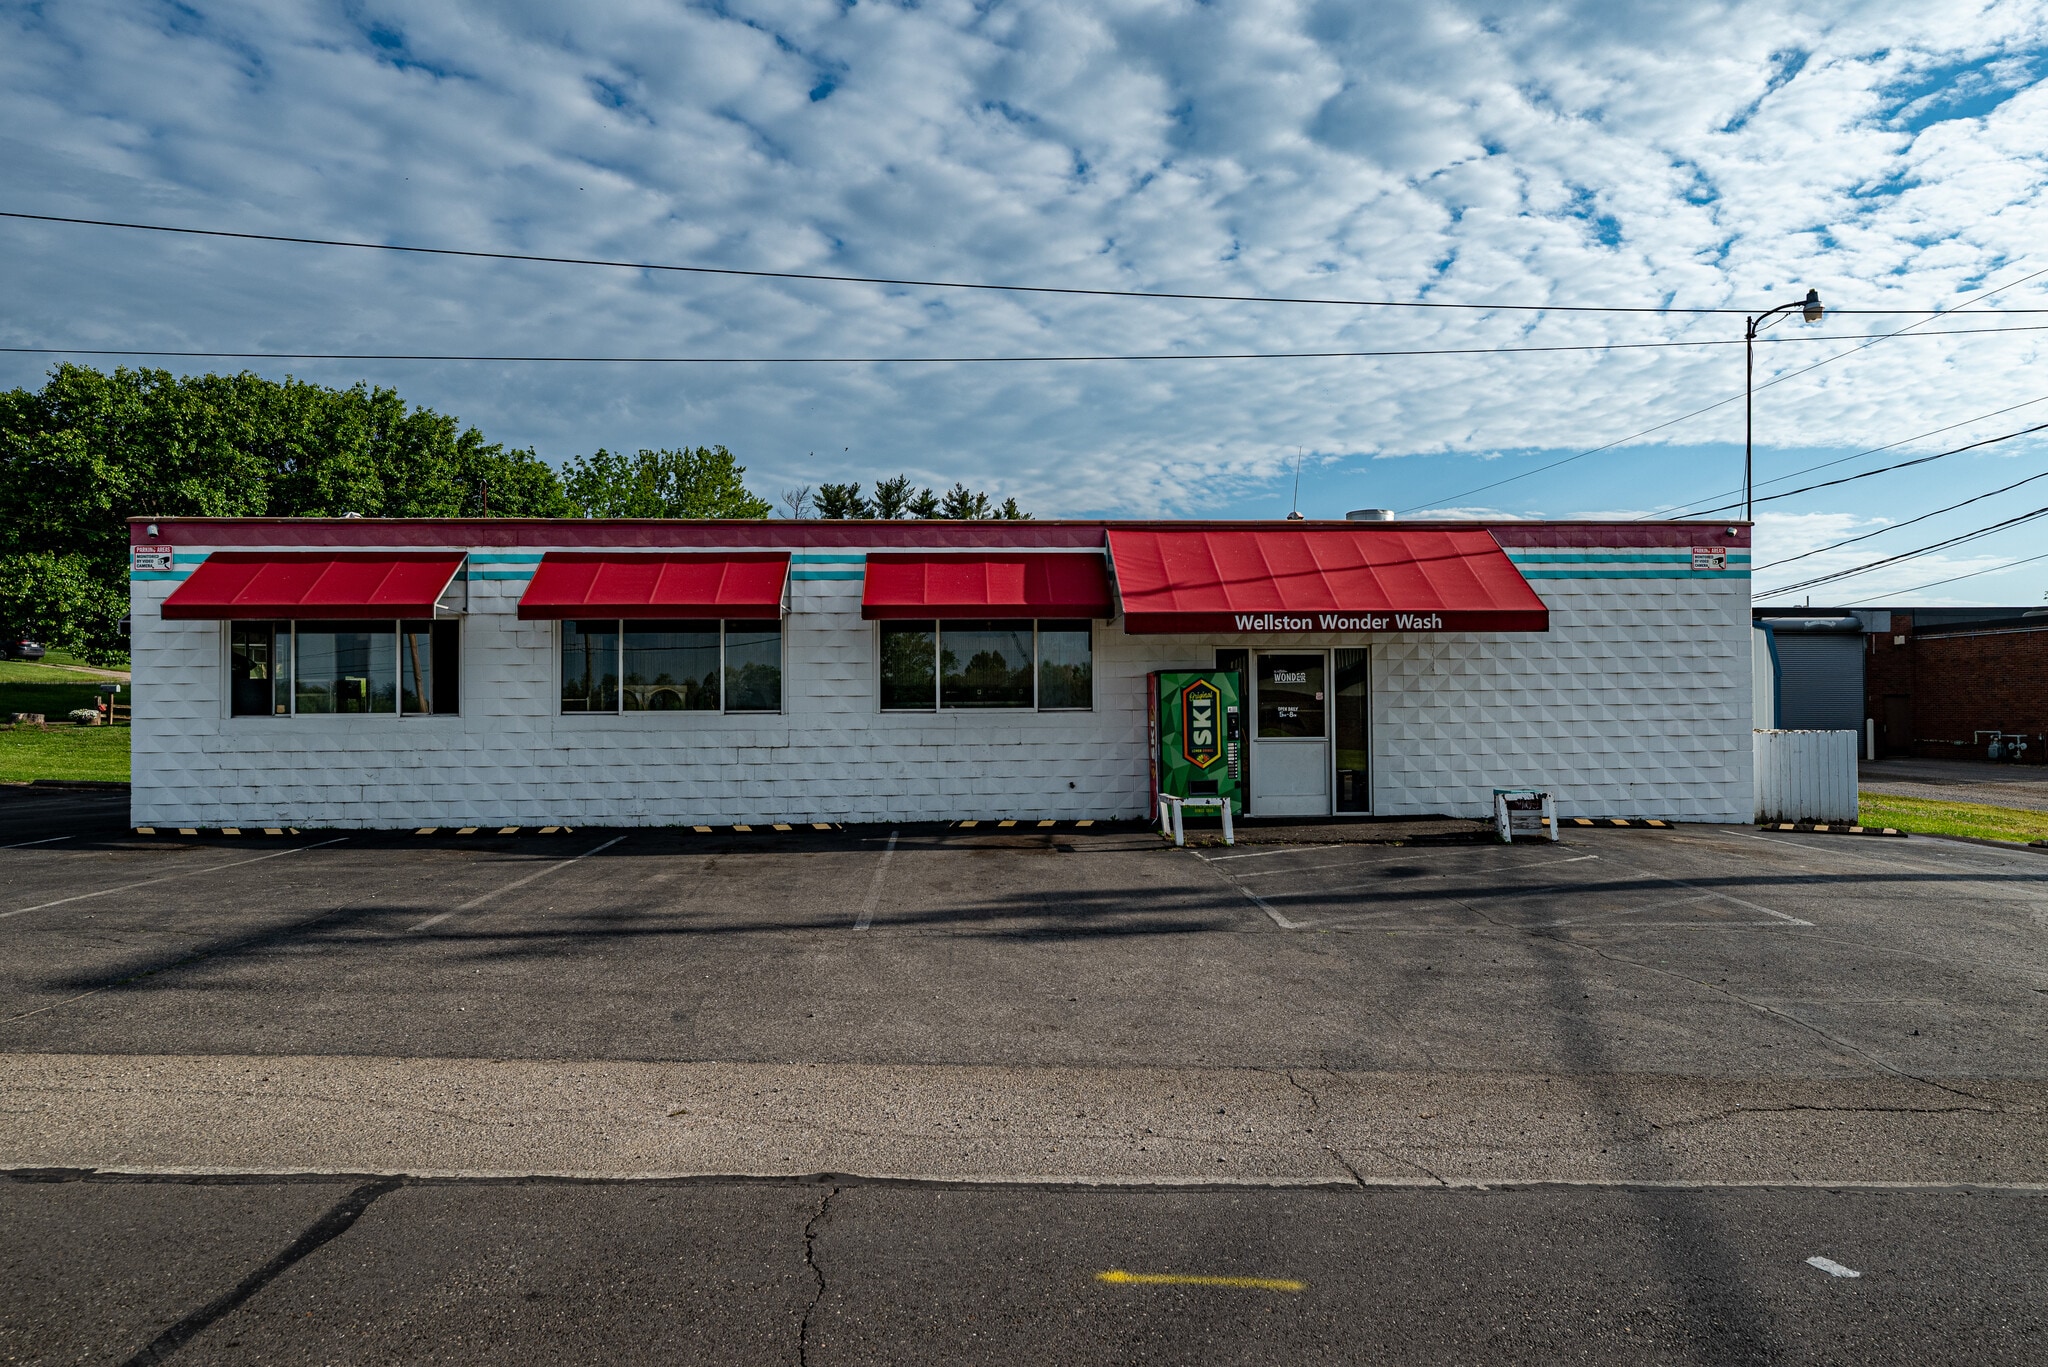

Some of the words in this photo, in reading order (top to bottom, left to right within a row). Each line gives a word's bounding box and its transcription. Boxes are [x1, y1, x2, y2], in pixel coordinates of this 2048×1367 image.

[1234, 614, 1313, 631] Wellston
[1318, 613, 1390, 630] Wonder
[1395, 613, 1443, 629] Wash
[1273, 672, 1307, 682] WONDER
[1188, 690, 1213, 702] Original
[1193, 699, 1212, 745] SKI
